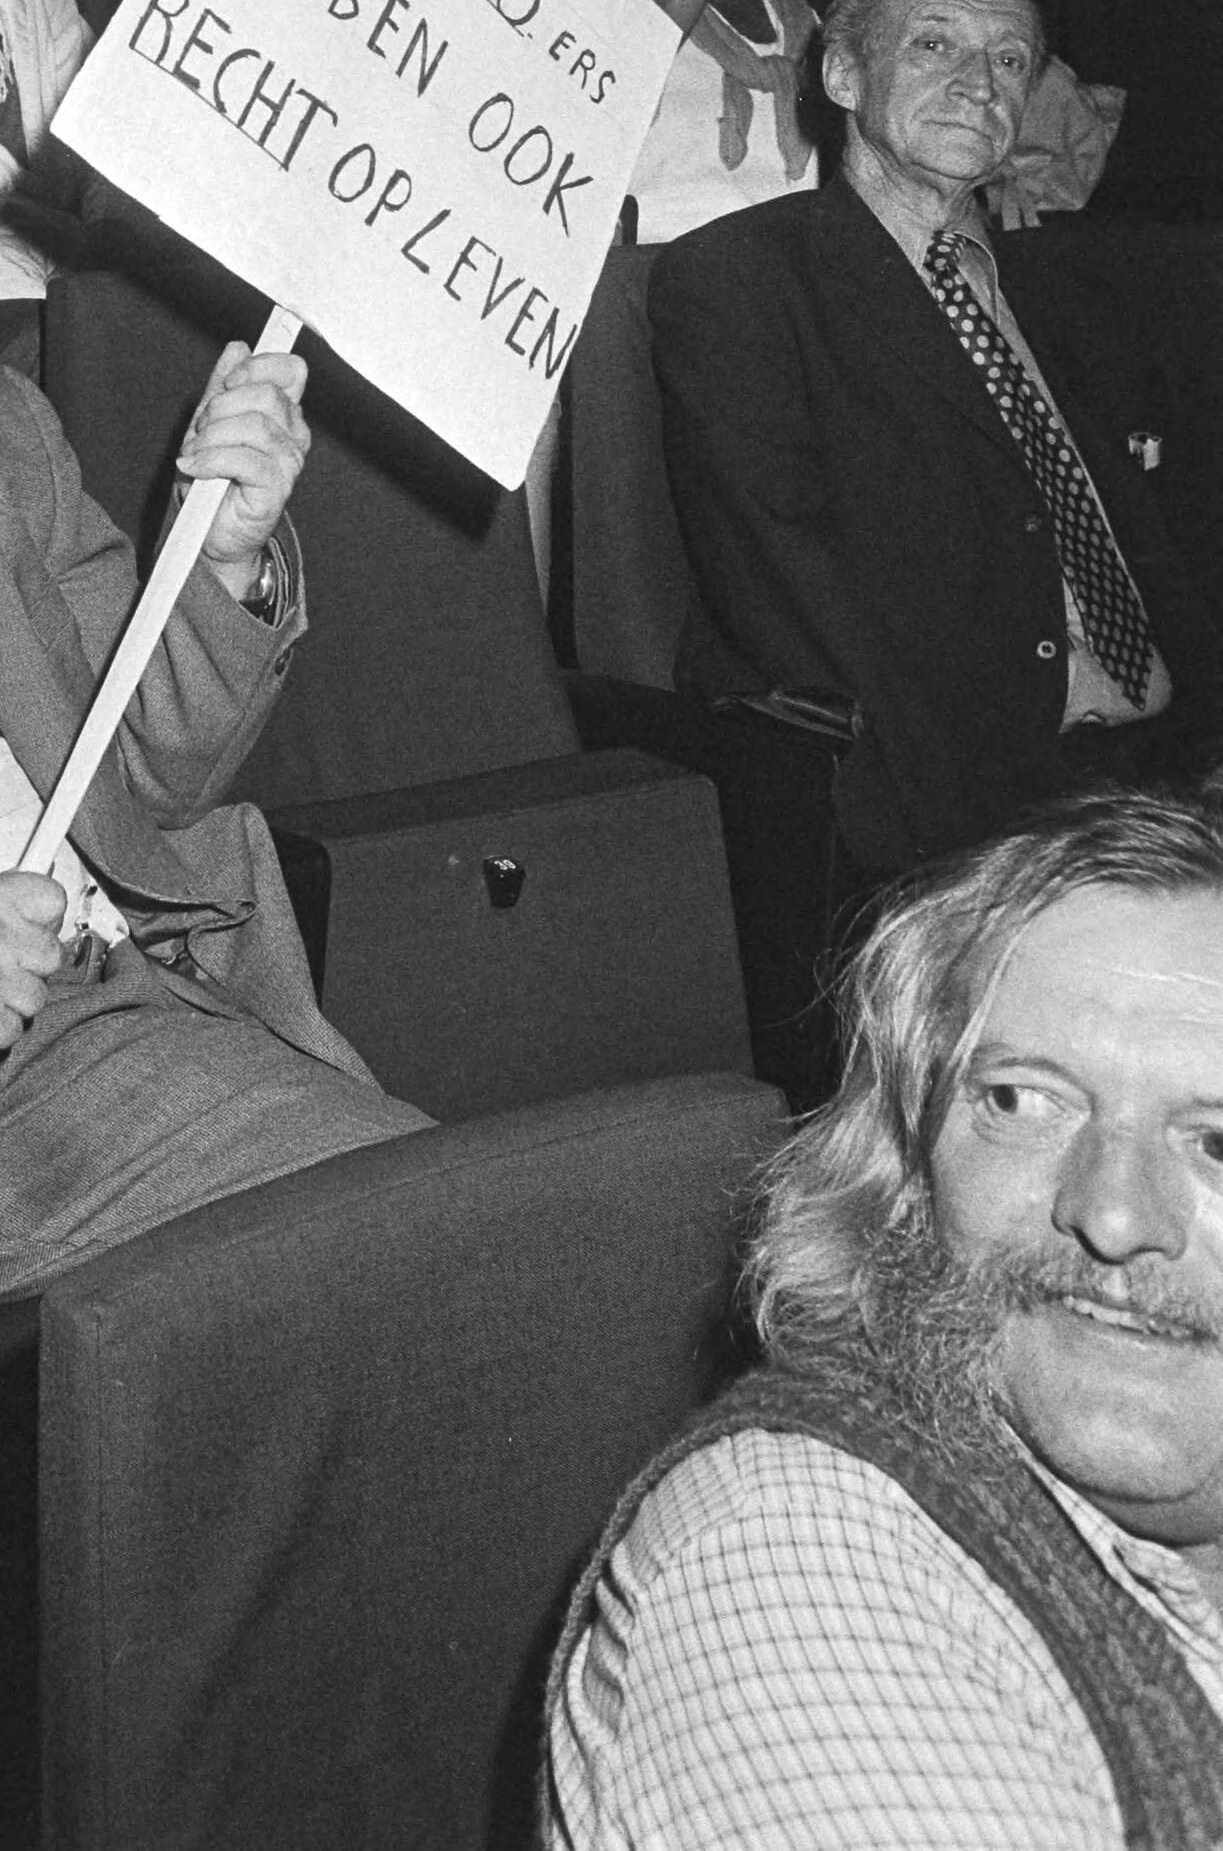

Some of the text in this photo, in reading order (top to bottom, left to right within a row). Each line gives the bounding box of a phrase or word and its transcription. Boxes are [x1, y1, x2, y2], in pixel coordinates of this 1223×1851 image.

[468, 92, 595, 235] OOK
[328, 143, 412, 227] OP
[401, 209, 578, 380] LEVEN
